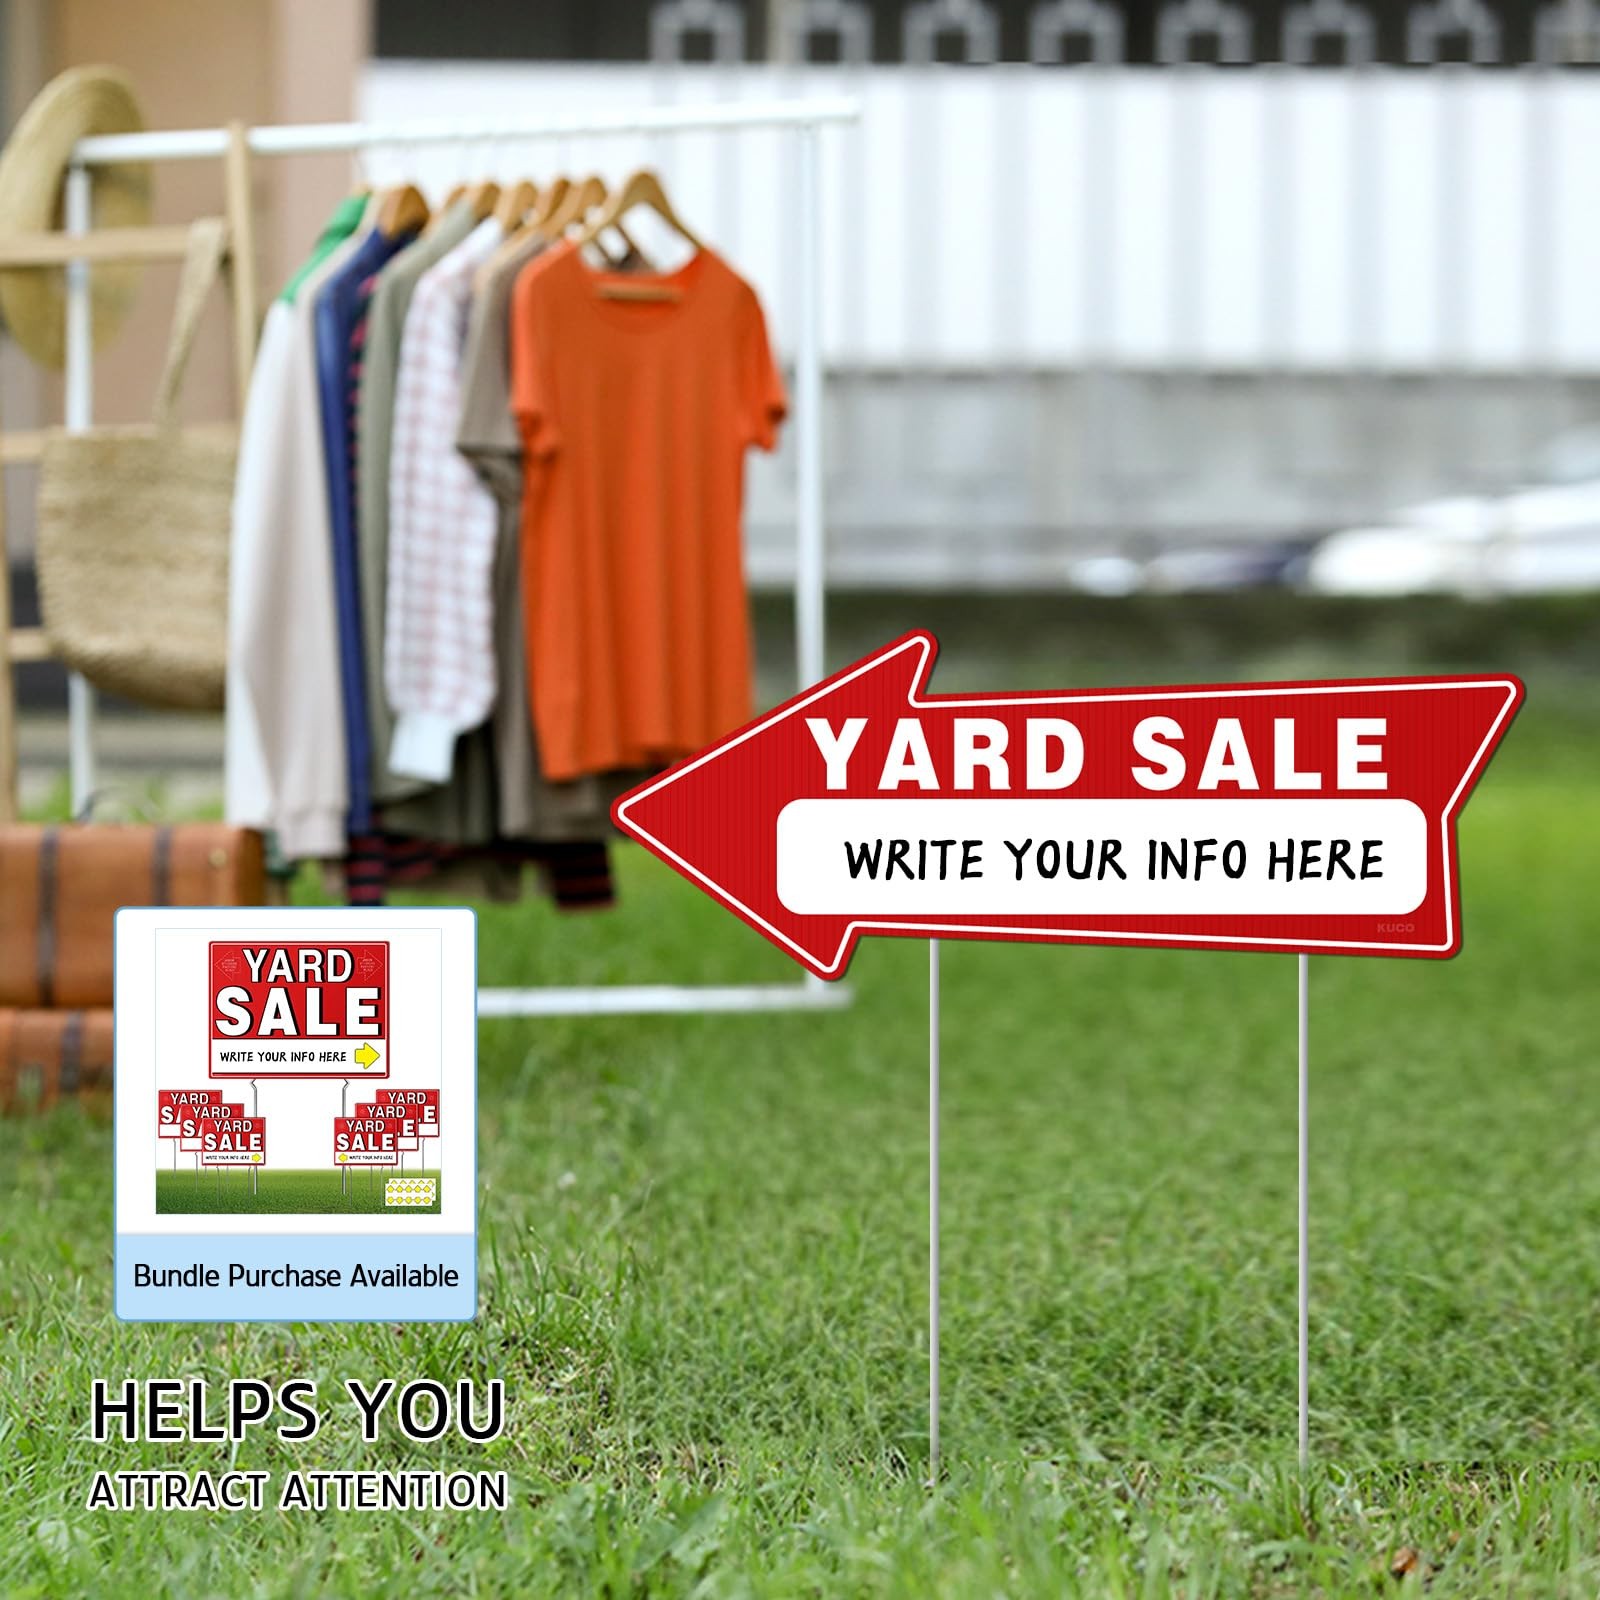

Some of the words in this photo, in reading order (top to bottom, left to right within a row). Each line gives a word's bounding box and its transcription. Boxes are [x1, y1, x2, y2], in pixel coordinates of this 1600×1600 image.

[805, 717, 1085, 790] YARD
[1132, 716, 1388, 791] SALE
[844, 838, 984, 881] WRITE
[1004, 838, 1127, 881] YOUR
[1148, 837, 1247, 882] INFO
[1268, 838, 1384, 883] HERE
